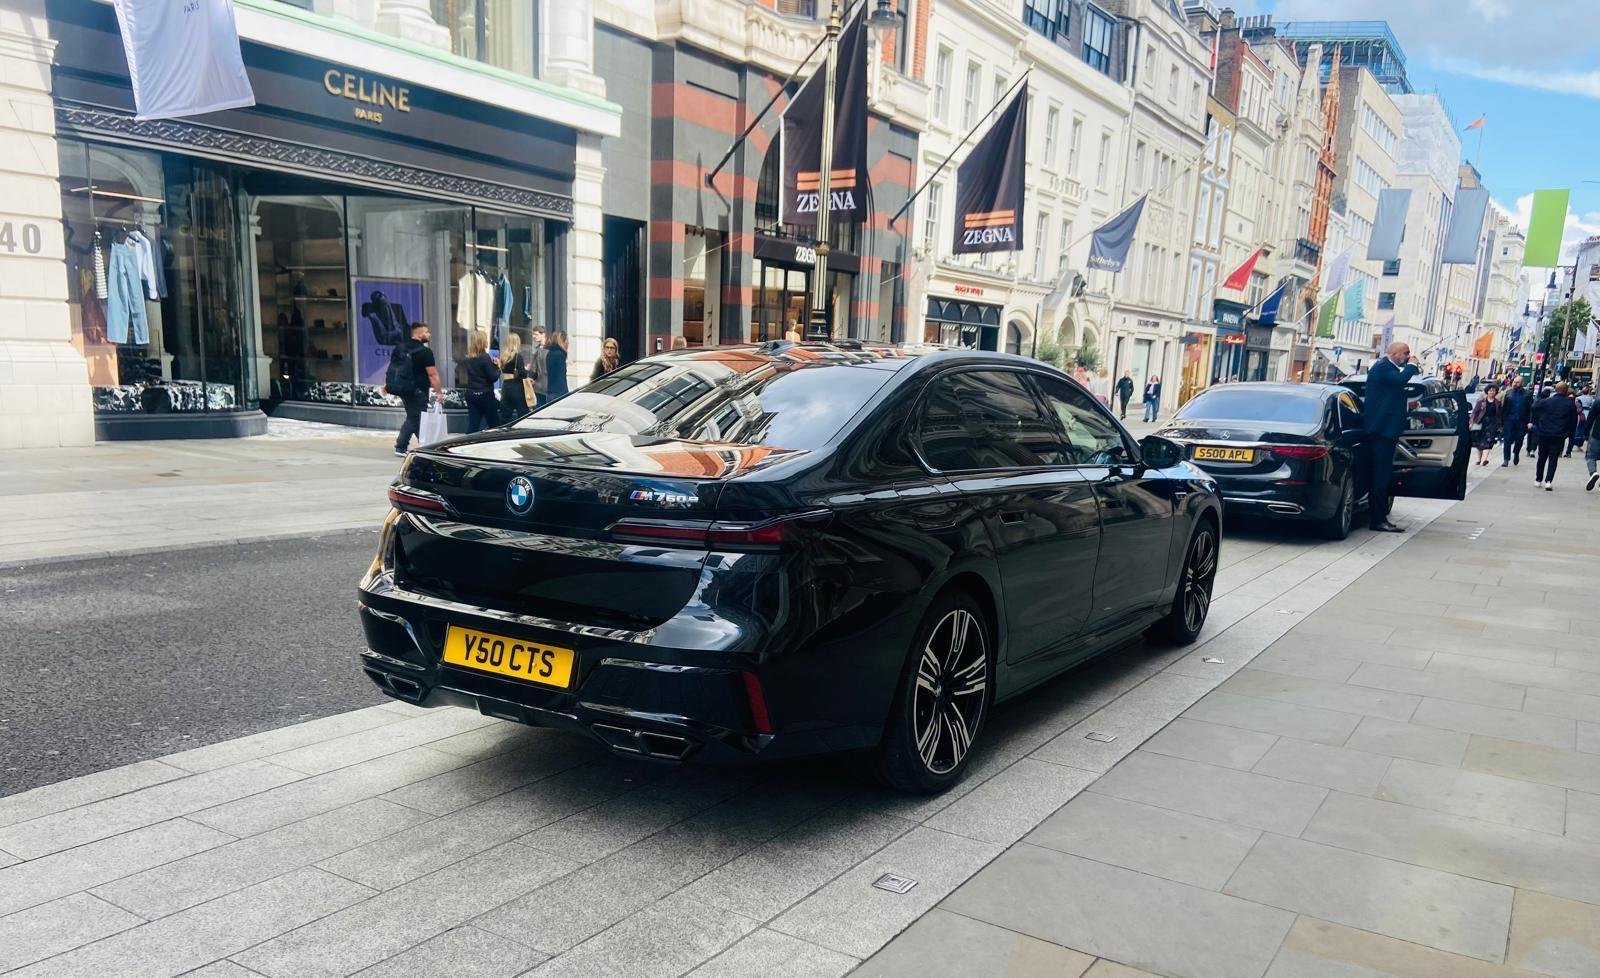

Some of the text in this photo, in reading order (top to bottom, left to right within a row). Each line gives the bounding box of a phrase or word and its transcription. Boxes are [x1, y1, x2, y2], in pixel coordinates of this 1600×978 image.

[324, 69, 410, 112] CELINE
[354, 107, 383, 124] PARIS
[796, 191, 856, 213] ZENA
[0, 222, 41, 254] 40
[964, 227, 1013, 244] ZEGNA
[796, 246, 816, 264] ZEG
[1199, 448, 1248, 460] S500 APL
[465, 634, 555, 677] Y50 CTS
